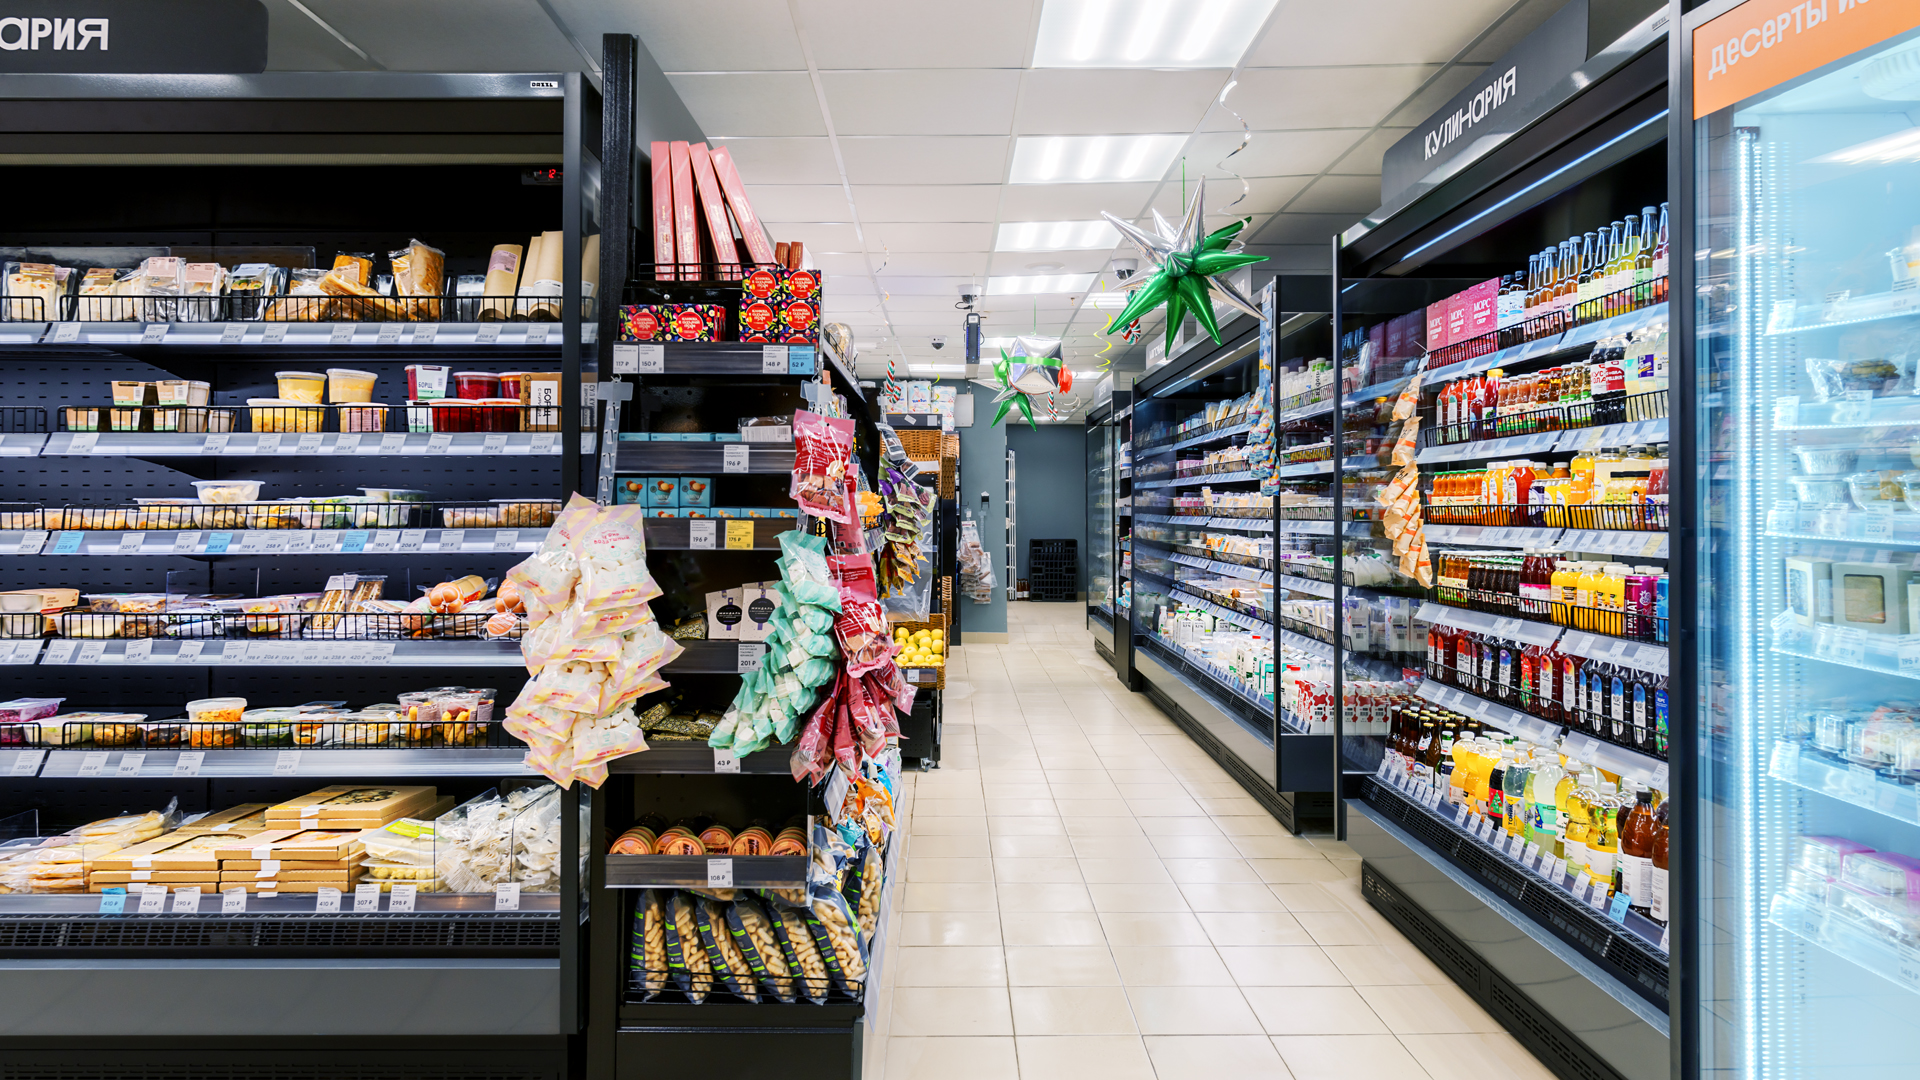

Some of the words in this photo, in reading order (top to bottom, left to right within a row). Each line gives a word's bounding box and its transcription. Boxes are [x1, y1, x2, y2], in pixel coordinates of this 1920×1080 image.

[1424, 65, 1517, 161] КУЛИНАРИЯ
[1473, 298, 1491, 312] МОРС
[1450, 308, 1464, 321] МОРС
